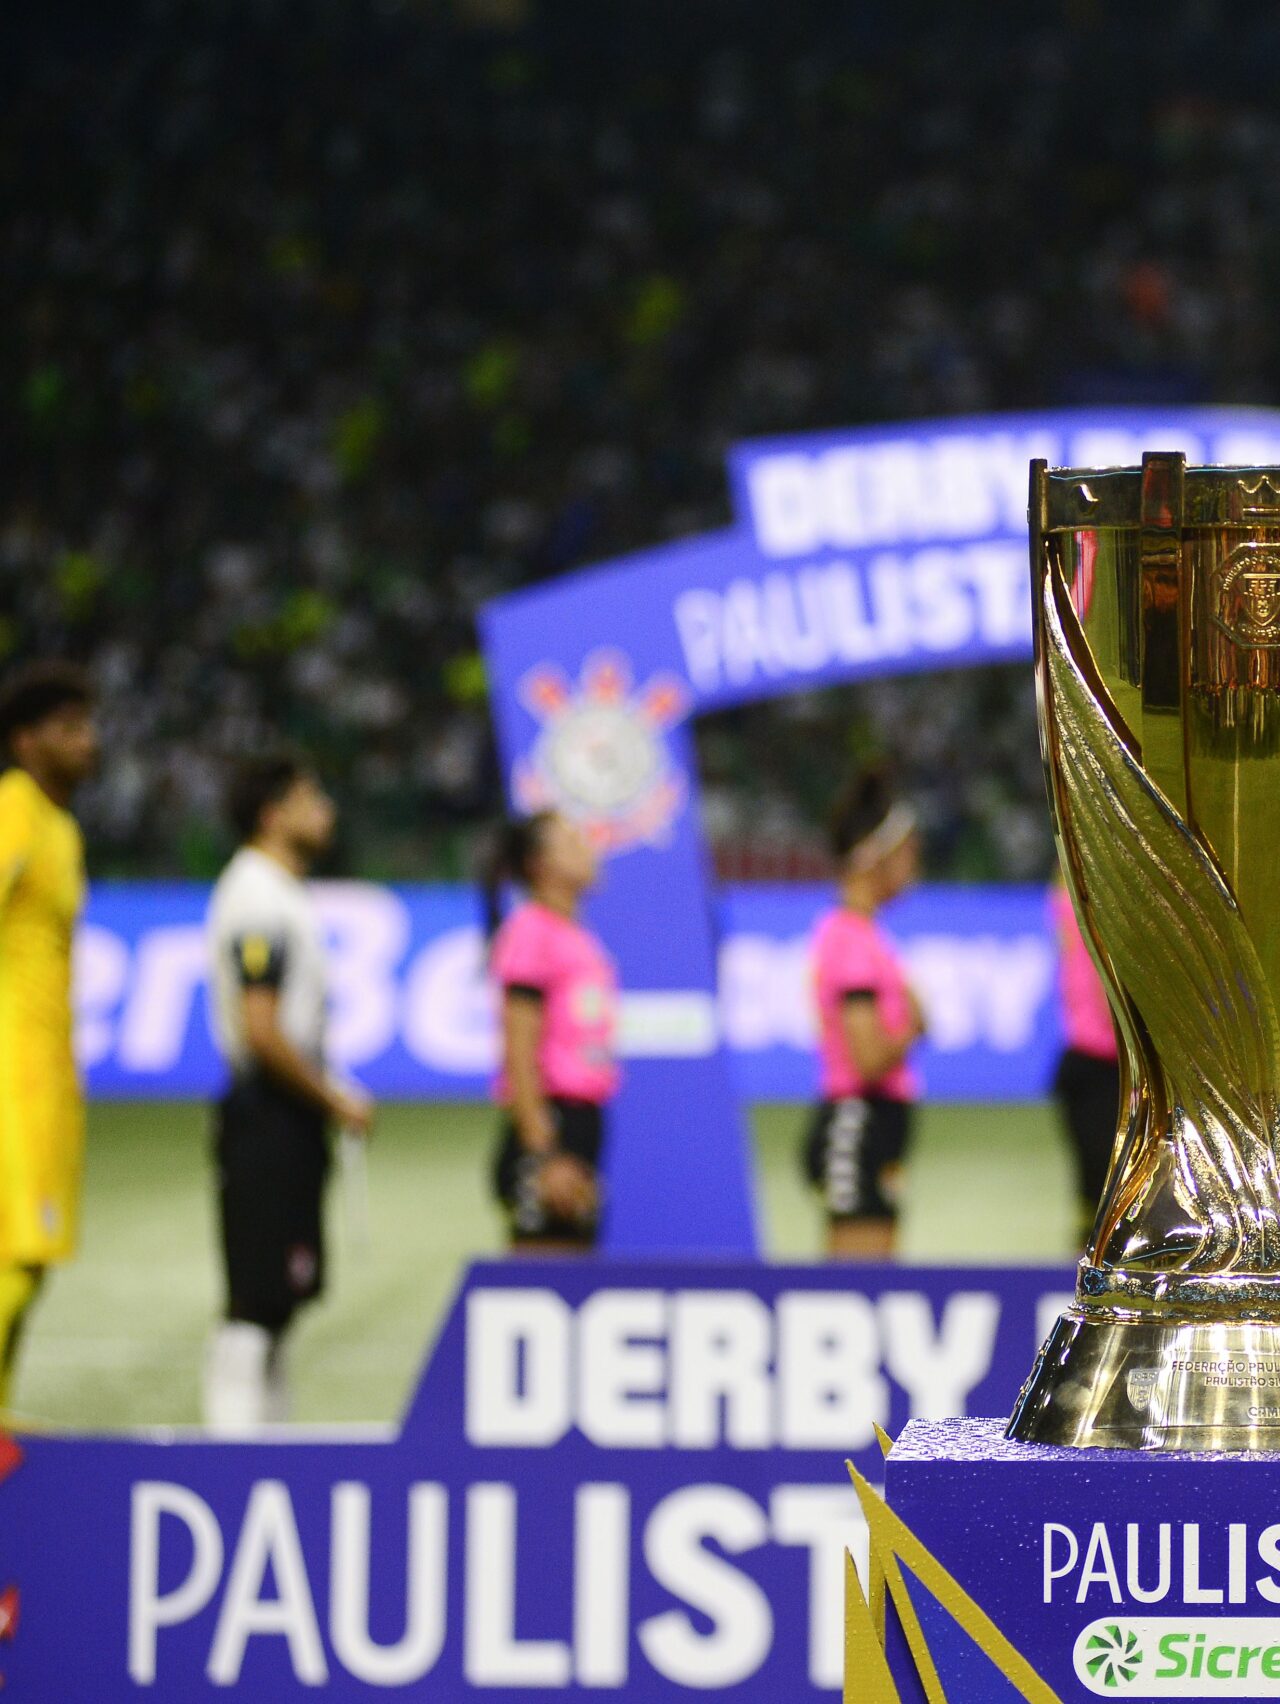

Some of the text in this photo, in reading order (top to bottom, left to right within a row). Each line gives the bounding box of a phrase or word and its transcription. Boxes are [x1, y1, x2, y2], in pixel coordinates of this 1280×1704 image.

[672, 544, 1033, 690] PAULIST
[466, 1287, 1000, 1450] DERBY
[1172, 1360, 1246, 1374] FEDERAÇÃO
[1205, 1375, 1266, 1387] PAULISTÃO
[128, 1479, 885, 1688] PAULIST
